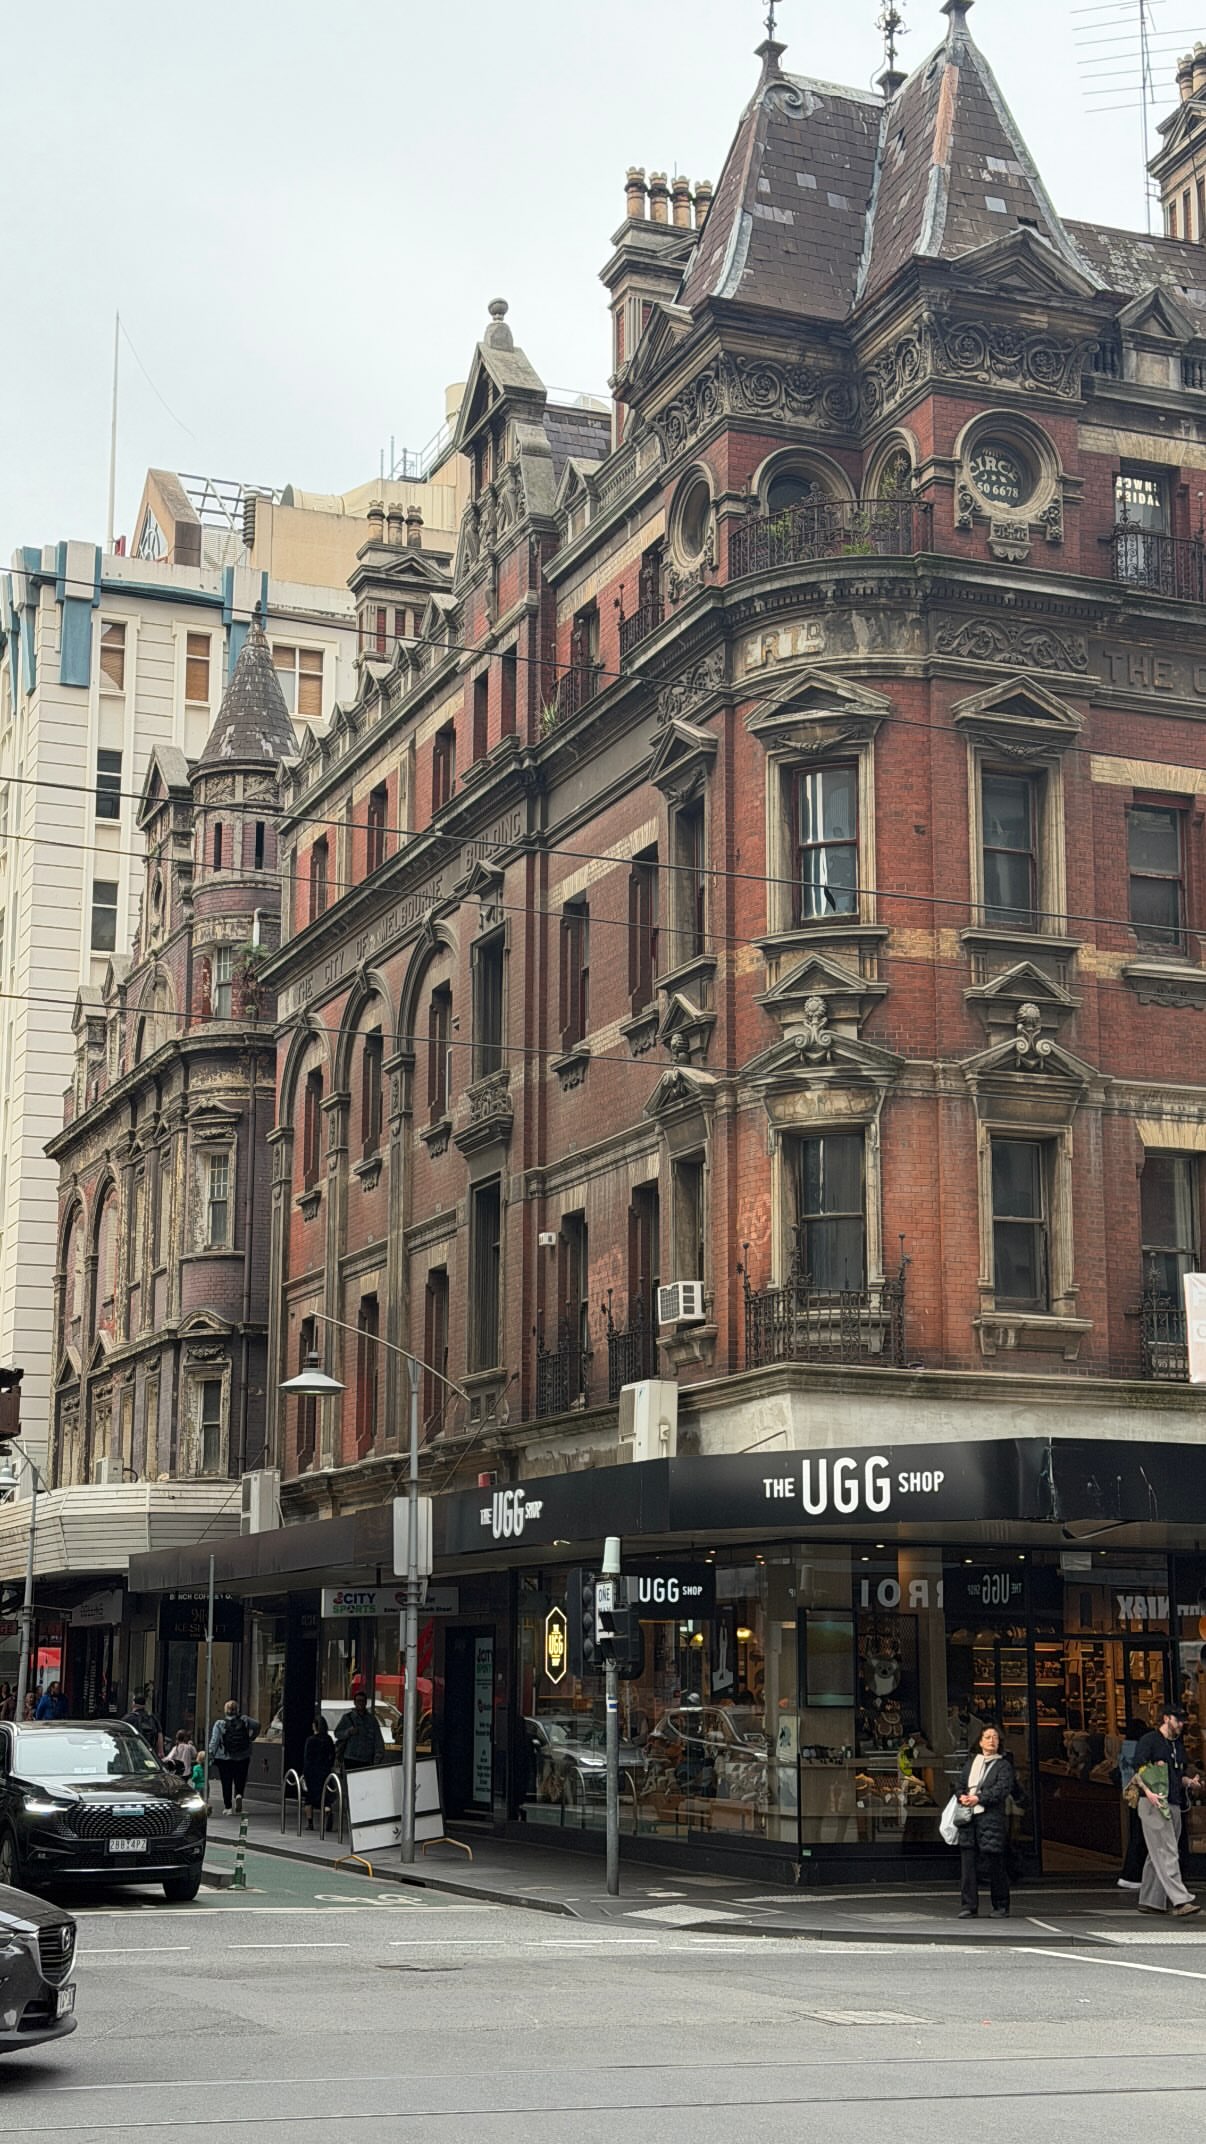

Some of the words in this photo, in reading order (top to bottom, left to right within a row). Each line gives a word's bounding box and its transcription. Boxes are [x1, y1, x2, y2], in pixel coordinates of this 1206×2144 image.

[992, 484, 1019, 499] 6678
[1103, 649, 1174, 689] THE
[297, 974, 314, 1004] THE
[325, 950, 345, 986] CITY
[356, 931, 369, 962] OF
[380, 876, 443, 944] MELBOURNE
[465, 811, 522, 873] BUILDING
[763, 1477, 795, 1498] THE
[802, 1455, 891, 1515] UGG
[898, 1470, 945, 1493] SHOP
[493, 1488, 525, 1539] UGG
[343, 1593, 376, 1604] CITY
[598, 1587, 611, 1602] ONE
[639, 1577, 680, 1603] UGG
[682, 1586, 703, 1596] SHOP
[333, 1605, 376, 1615] SPORTS
[548, 1634, 563, 1655] UGG
